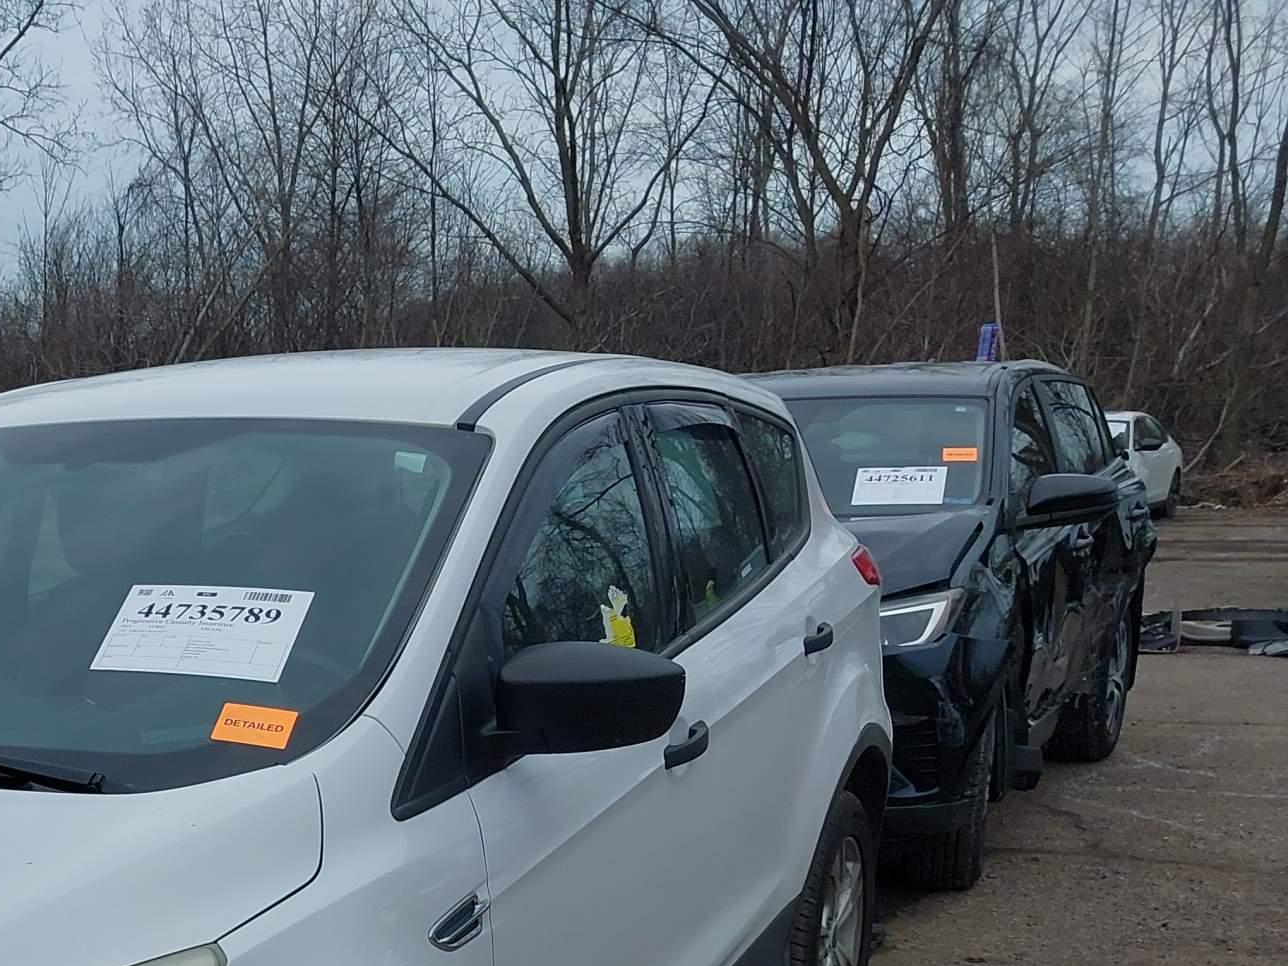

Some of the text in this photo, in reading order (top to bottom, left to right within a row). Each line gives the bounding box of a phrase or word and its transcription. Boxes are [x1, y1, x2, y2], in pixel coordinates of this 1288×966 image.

[864, 474, 935, 482] 44725611
[137, 602, 282, 625] 44735789
[224, 718, 284, 733] DETAILED
